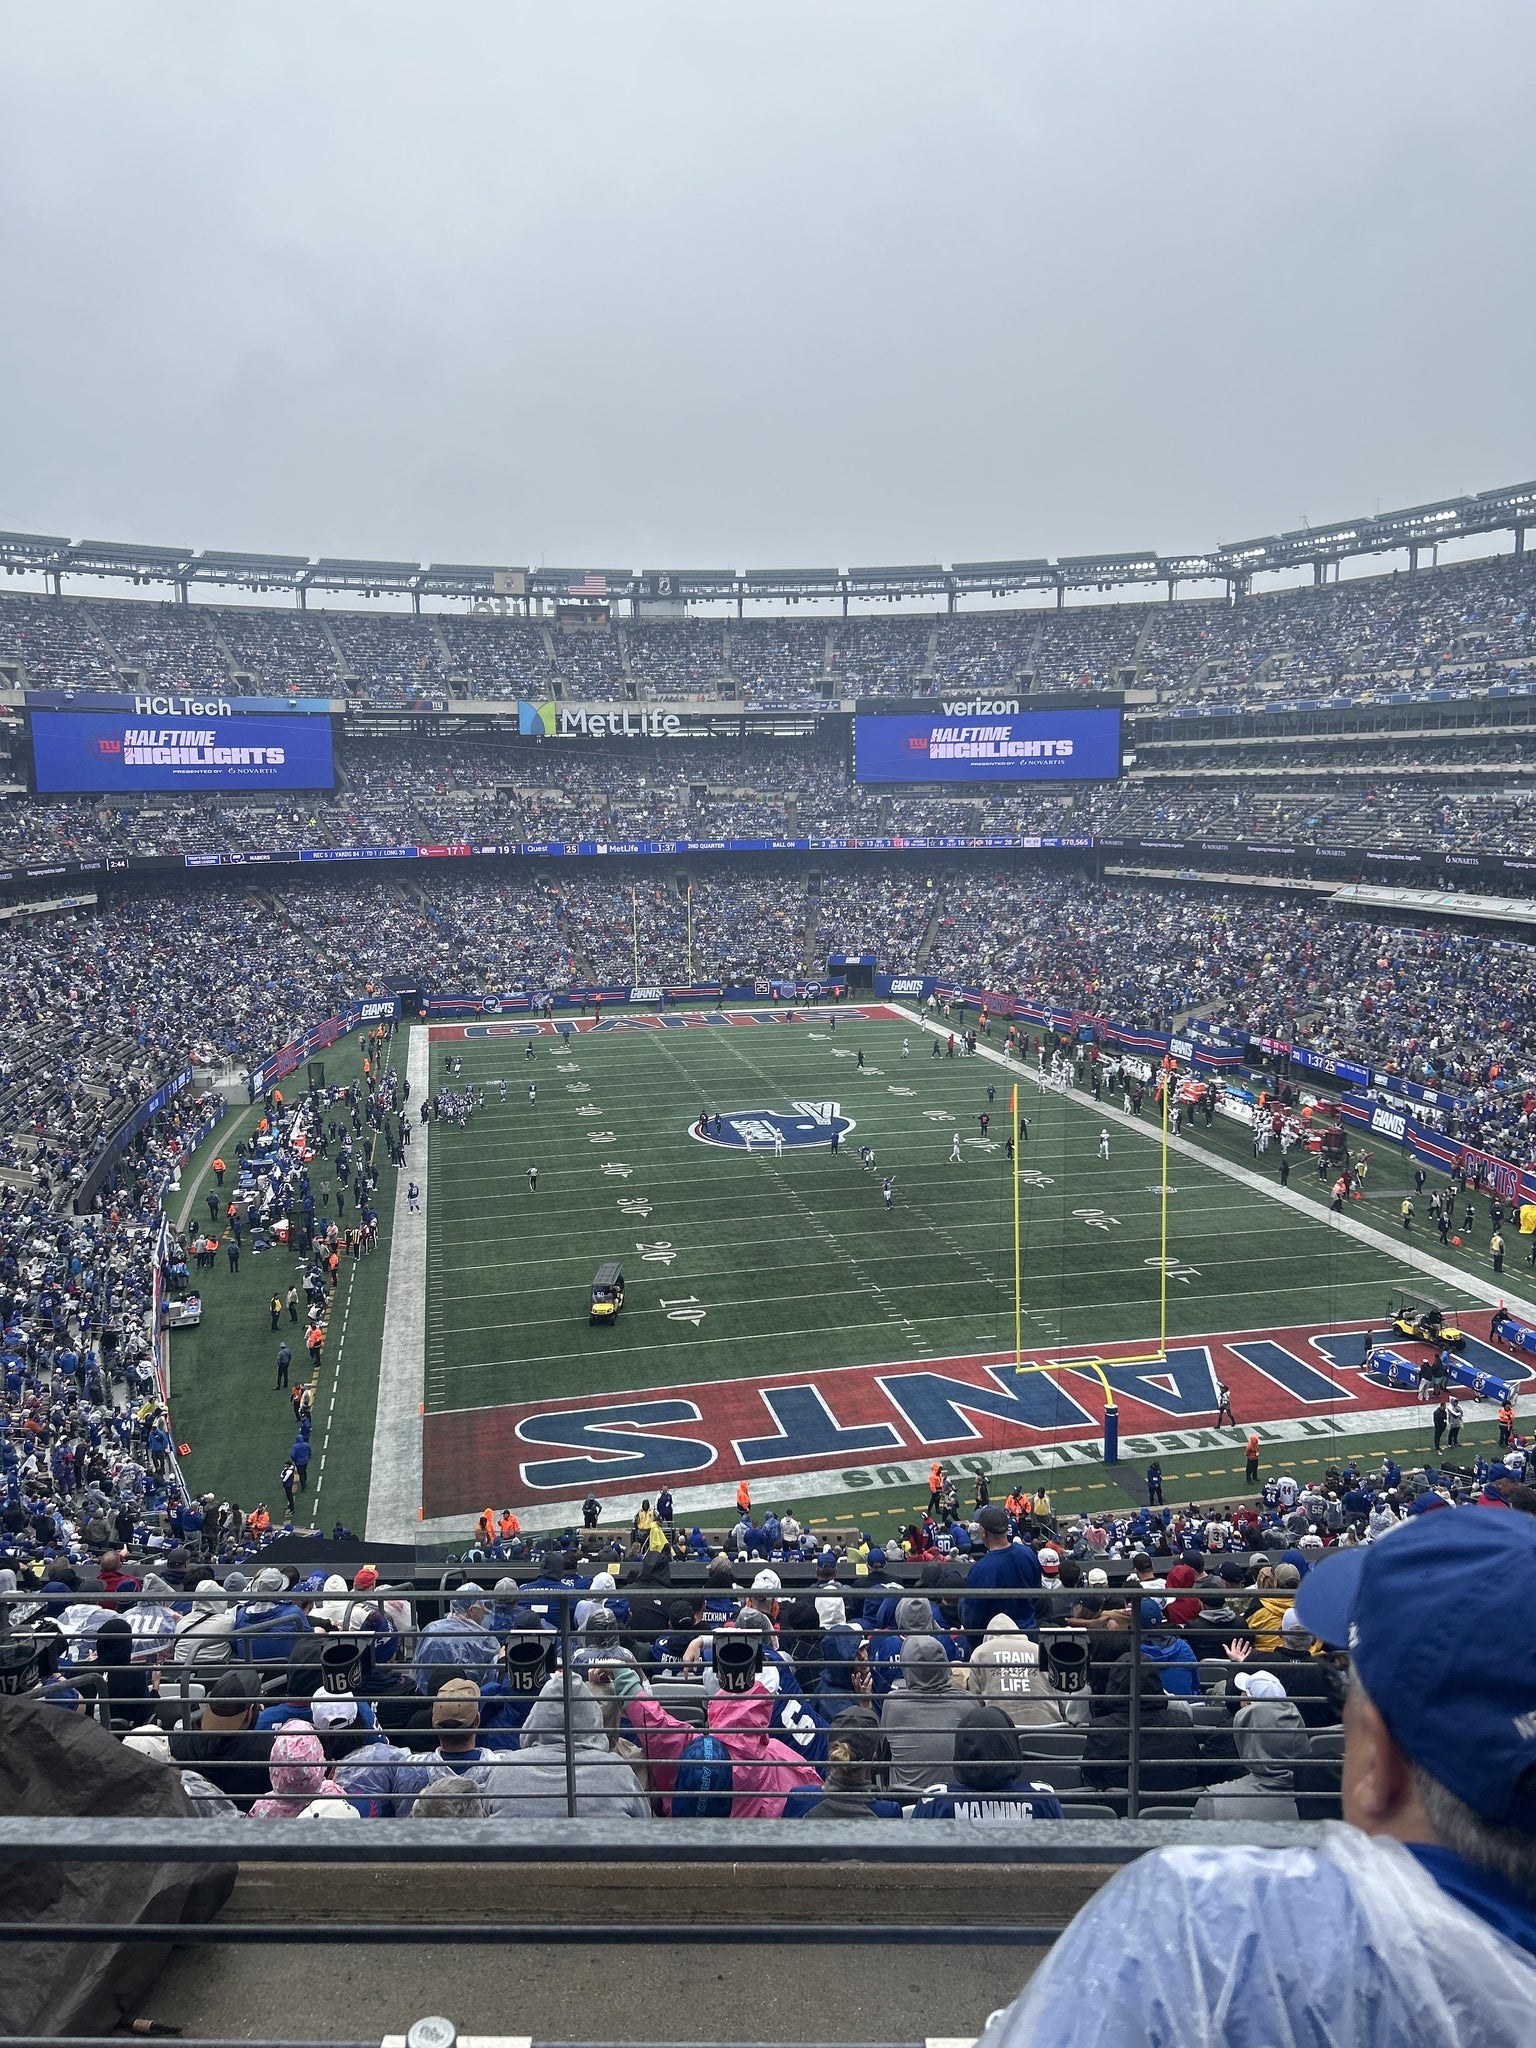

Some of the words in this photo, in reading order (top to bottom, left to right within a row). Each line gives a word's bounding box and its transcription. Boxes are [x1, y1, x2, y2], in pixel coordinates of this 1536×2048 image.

[135, 697, 231, 716] HCLTech
[942, 697, 1019, 717] verizon
[562, 708, 681, 734] MetLife
[125, 730, 216, 746] HALFTIME
[931, 727, 1012, 742] HALFTIME
[98, 740, 121, 753] ny
[909, 738, 928, 749] ny
[930, 740, 1073, 759] HIGHLIGHTS
[124, 747, 285, 765] HIGHLIGHTS
[498, 846, 510, 854] 19
[566, 845, 577, 853] 25
[657, 844, 675, 852] 1:37
[1061, 838, 1088, 847] $70,565
[447, 847, 458, 855] 17
[1451, 857, 1479, 865] NOVARTIS
[630, 988, 663, 998] GIANTS
[757, 983, 768, 993] 25
[891, 980, 923, 991] GIANTS
[362, 1002, 394, 1016] GIANTS
[464, 1009, 870, 1039] GIANTS
[1170, 1038, 1193, 1057] GIANTS
[1307, 1053, 1323, 1068] 1:37
[1324, 1059, 1335, 1072] 25
[1371, 1108, 1406, 1136] GIANTS
[586, 1131, 617, 1143] 50
[600, 1162, 634, 1176] 40
[1013, 1169, 1055, 1185] 30
[616, 1197, 653, 1214] 30
[1072, 1209, 1122, 1226] 20
[280, 1231, 287, 1239] G
[635, 1241, 677, 1261] 20
[1144, 1257, 1202, 1278] 10
[659, 1295, 707, 1321] 10
[514, 1327, 1536, 1489] GIANTS
[121, 1422, 131, 1432] 44
[1299, 1418, 1346, 1435] IT
[1124, 1424, 1283, 1454] TAKES
[1011, 1439, 1104, 1468] ALL
[936, 1454, 993, 1478] OF
[842, 1465, 911, 1488] US
[1282, 1486, 1292, 1495] 44
[1311, 1505, 1323, 1515] 56
[938, 1539, 950, 1551] 90
[993, 1651, 1035, 1664] TRAIN
[1, 1676, 17, 1693] 17
[327, 1673, 347, 1691] 16
[514, 1672, 532, 1690] 15
[727, 1673, 745, 1690] 14
[1001, 1678, 1031, 1692] LIFE
[1060, 1672, 1078, 1690] 13
[954, 1801, 1033, 1820] MANNING
